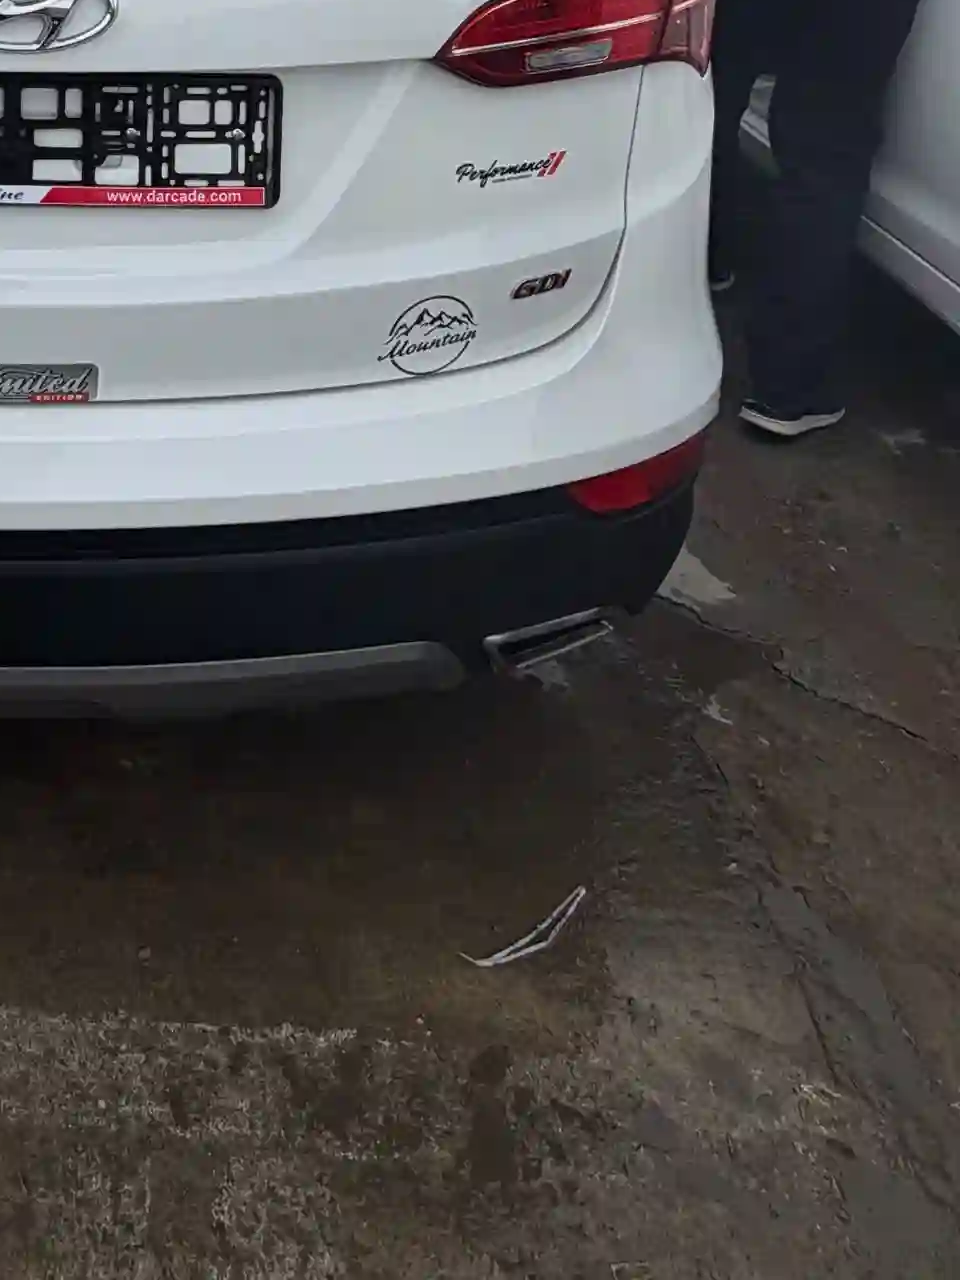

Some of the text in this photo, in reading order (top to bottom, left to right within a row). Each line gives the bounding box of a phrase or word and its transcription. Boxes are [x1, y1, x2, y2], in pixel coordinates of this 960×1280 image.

[455, 159, 553, 188] Performance
[106, 190, 242, 203] www.darcade.com
[377, 329, 477, 361] Mountain
